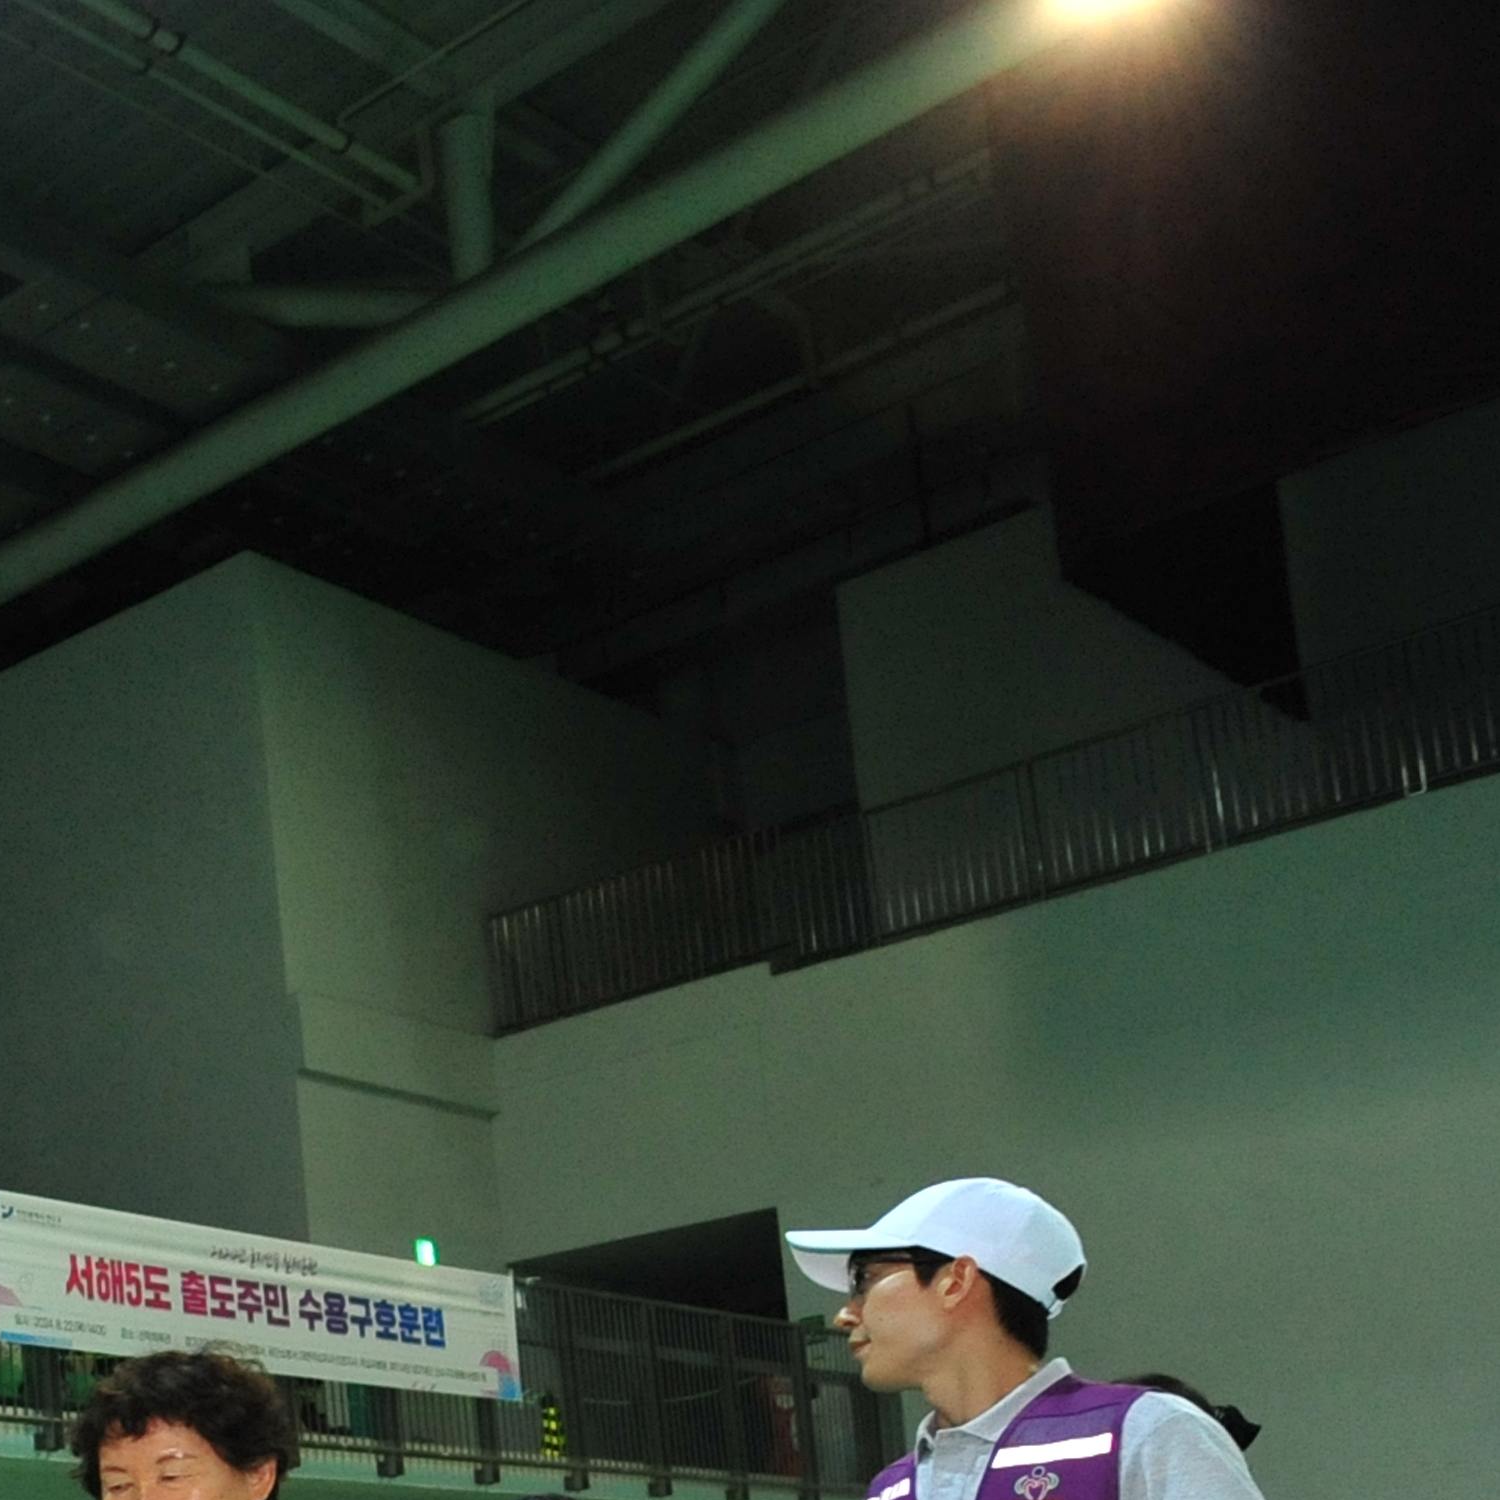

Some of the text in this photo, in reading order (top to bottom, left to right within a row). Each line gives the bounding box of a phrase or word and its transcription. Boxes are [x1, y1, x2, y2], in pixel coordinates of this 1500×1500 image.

[66, 1254, 172, 1311] 서해5도
[180, 1270, 290, 1327] 출도주민
[298, 1289, 446, 1349] 수용구호훈련
